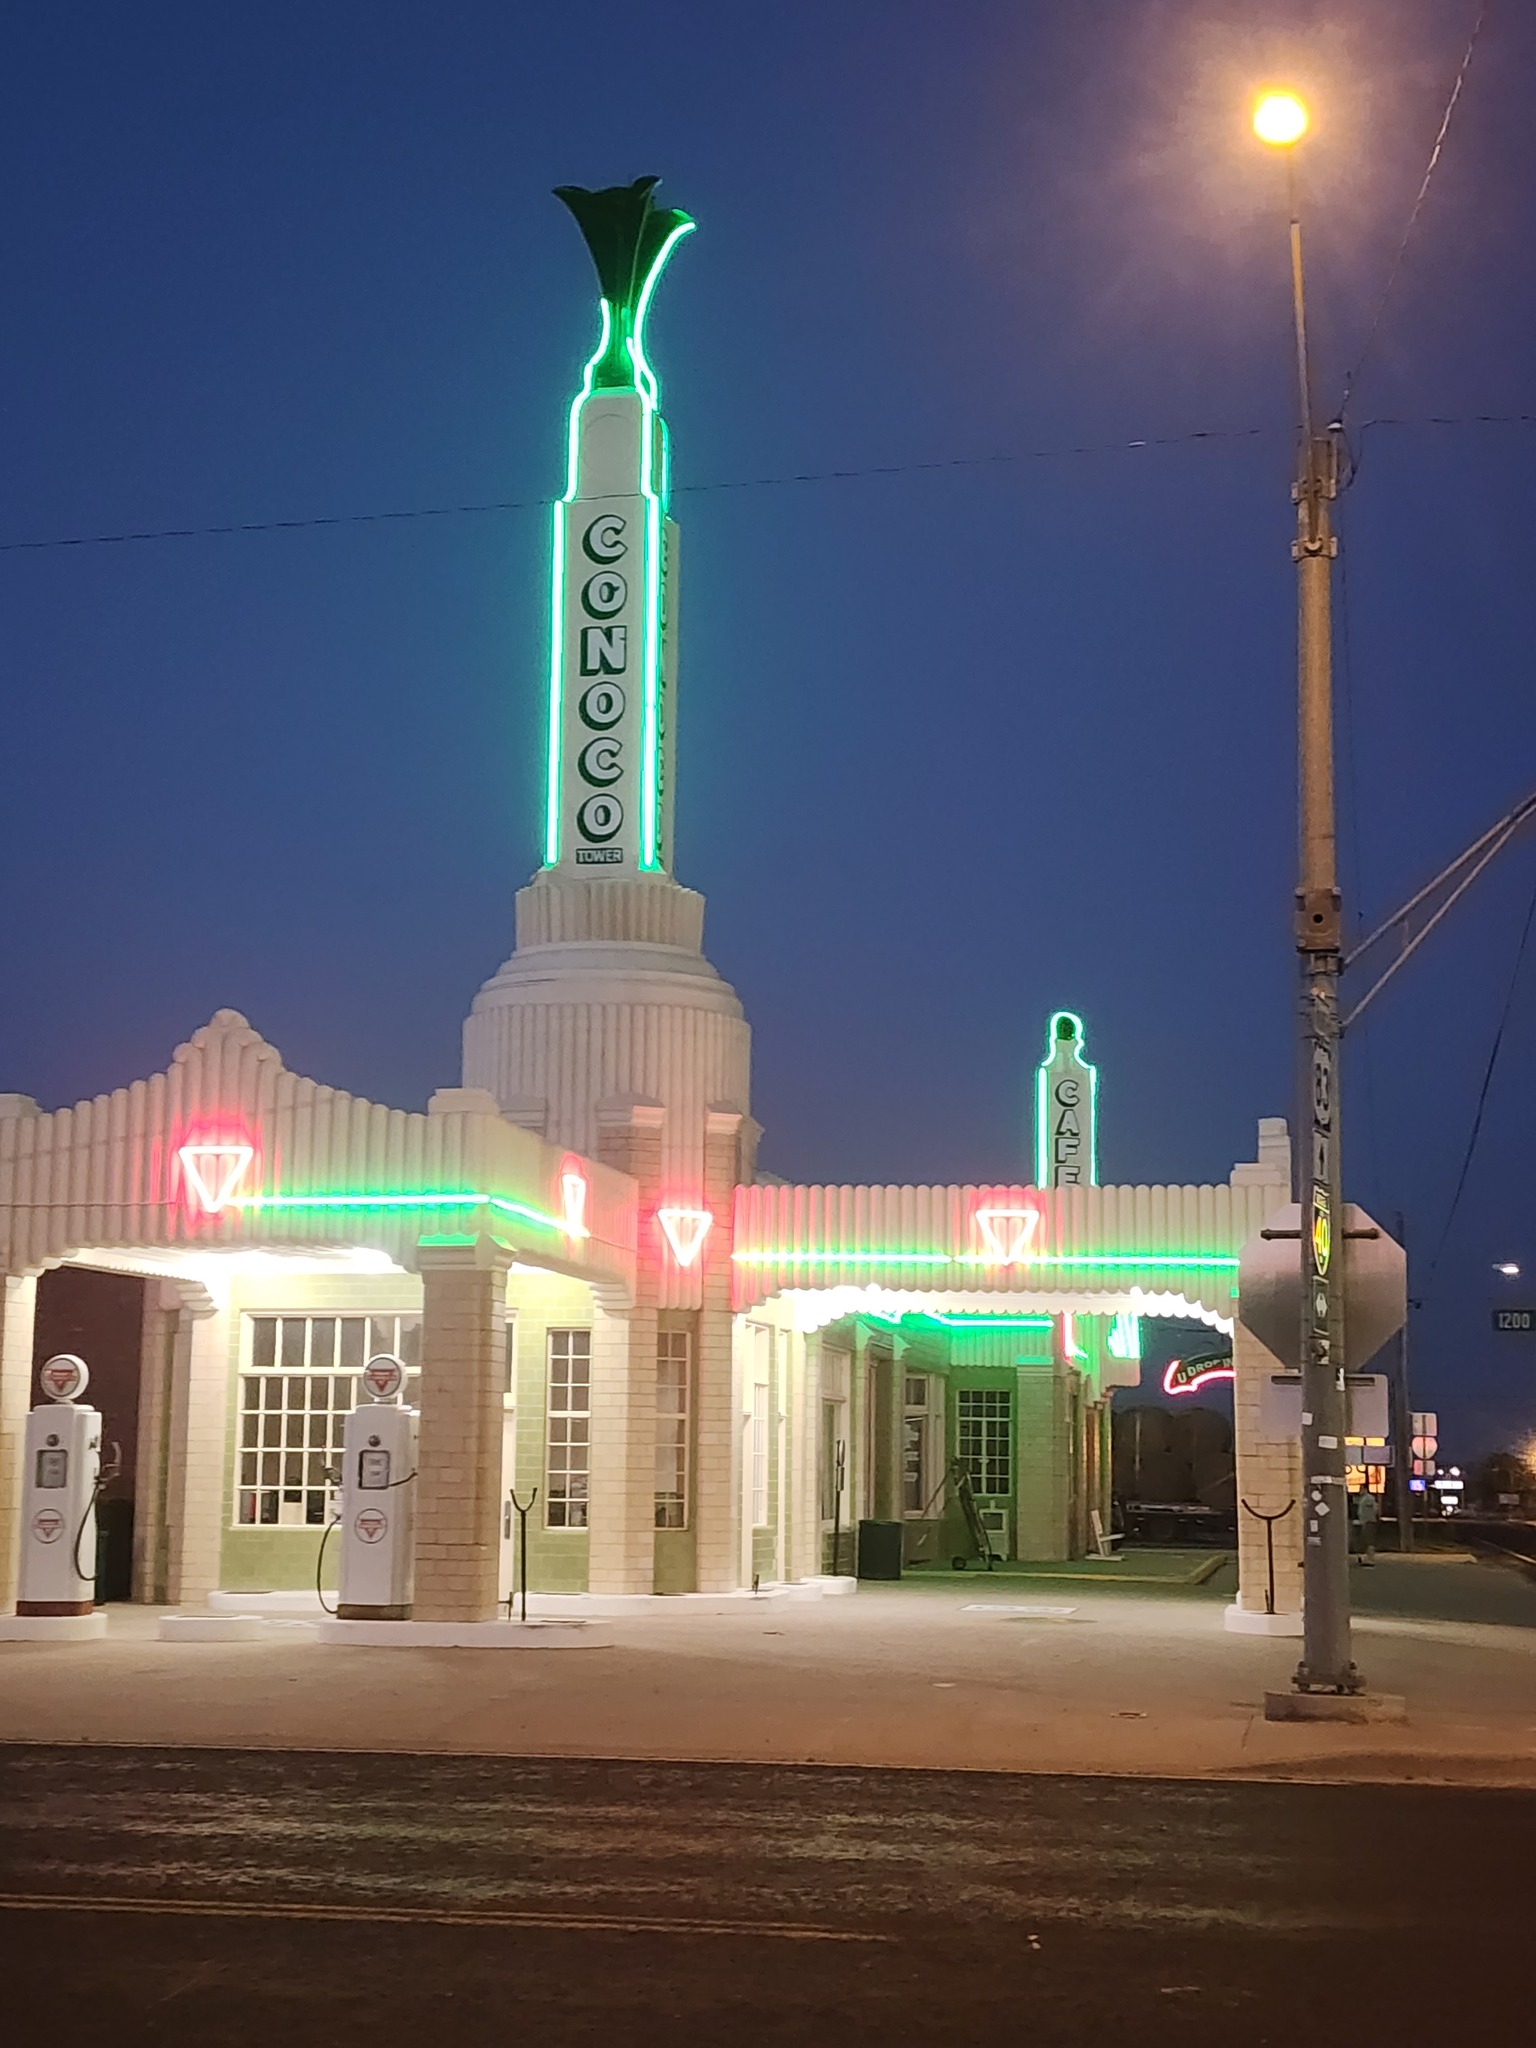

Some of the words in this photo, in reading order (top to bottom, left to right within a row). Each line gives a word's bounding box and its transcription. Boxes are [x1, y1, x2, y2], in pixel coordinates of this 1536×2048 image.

[576, 514, 628, 843] CONOCO
[577, 849, 622, 863] TOWER
[1054, 1079, 1081, 1189] CAFE
[1498, 1313, 1530, 1329] 1200
[1177, 1371, 1187, 1384] U
